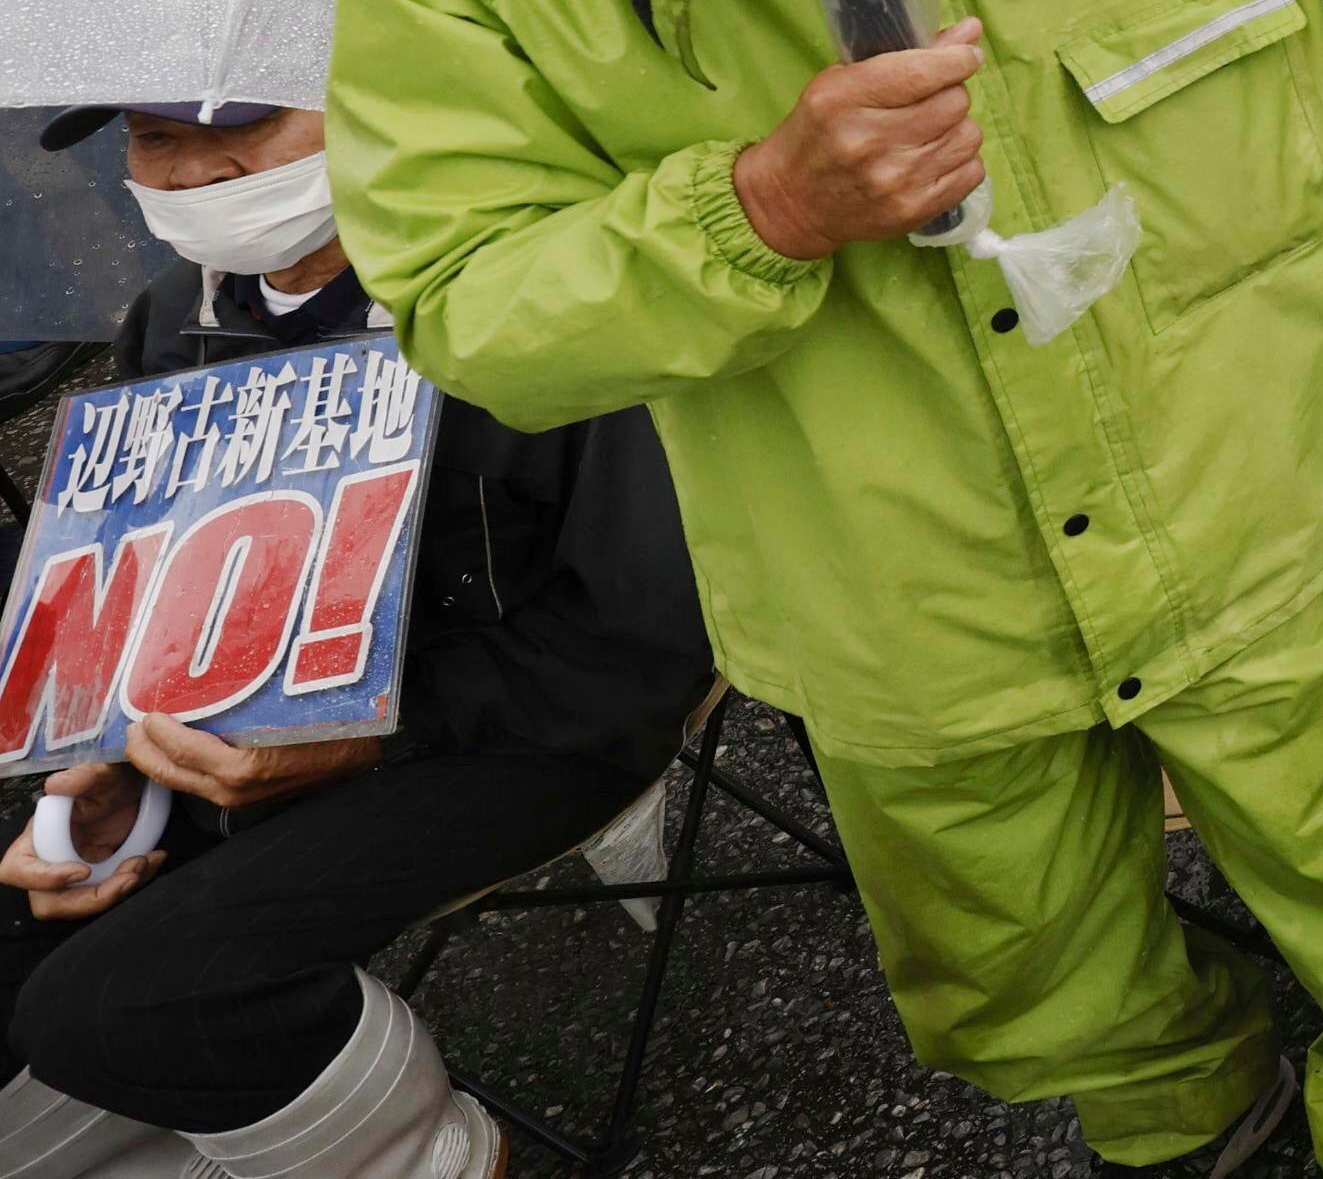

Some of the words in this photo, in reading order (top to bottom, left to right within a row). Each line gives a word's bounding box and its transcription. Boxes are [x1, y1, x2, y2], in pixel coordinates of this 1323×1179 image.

[57, 348, 423, 518] 辺野古新基地
[0, 459, 422, 763] NO!
